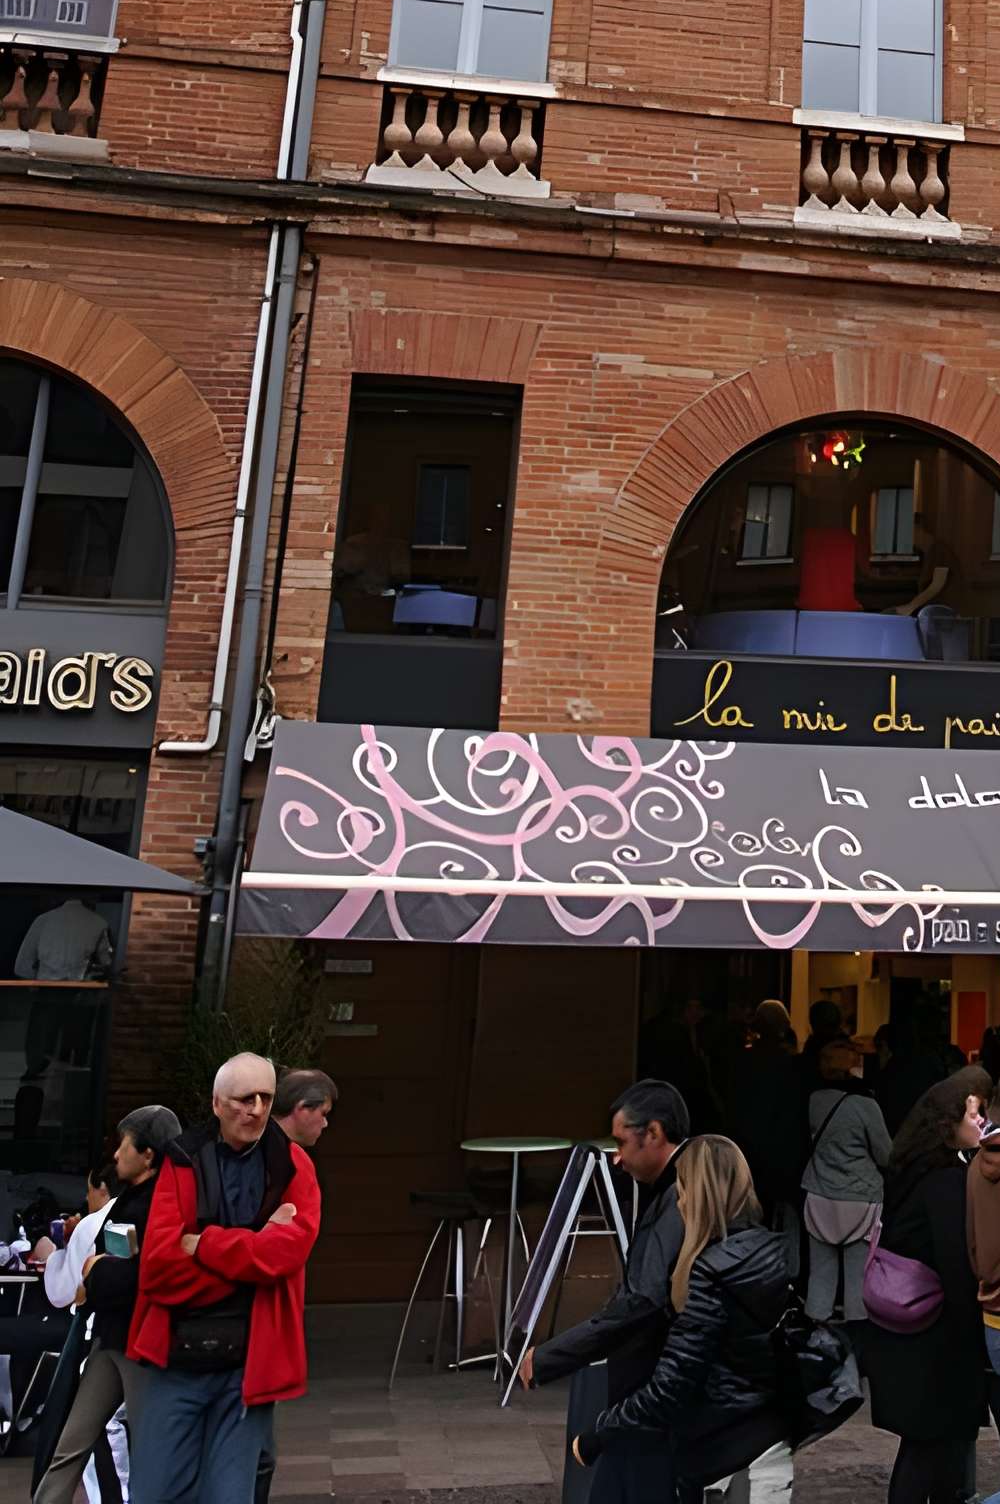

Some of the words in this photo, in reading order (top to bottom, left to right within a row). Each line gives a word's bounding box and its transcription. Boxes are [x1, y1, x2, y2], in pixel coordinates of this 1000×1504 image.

[673, 660, 754, 727] la
[782, 701, 848, 732] mie
[873, 675, 925, 732] de
[819, 768, 868, 808] la
